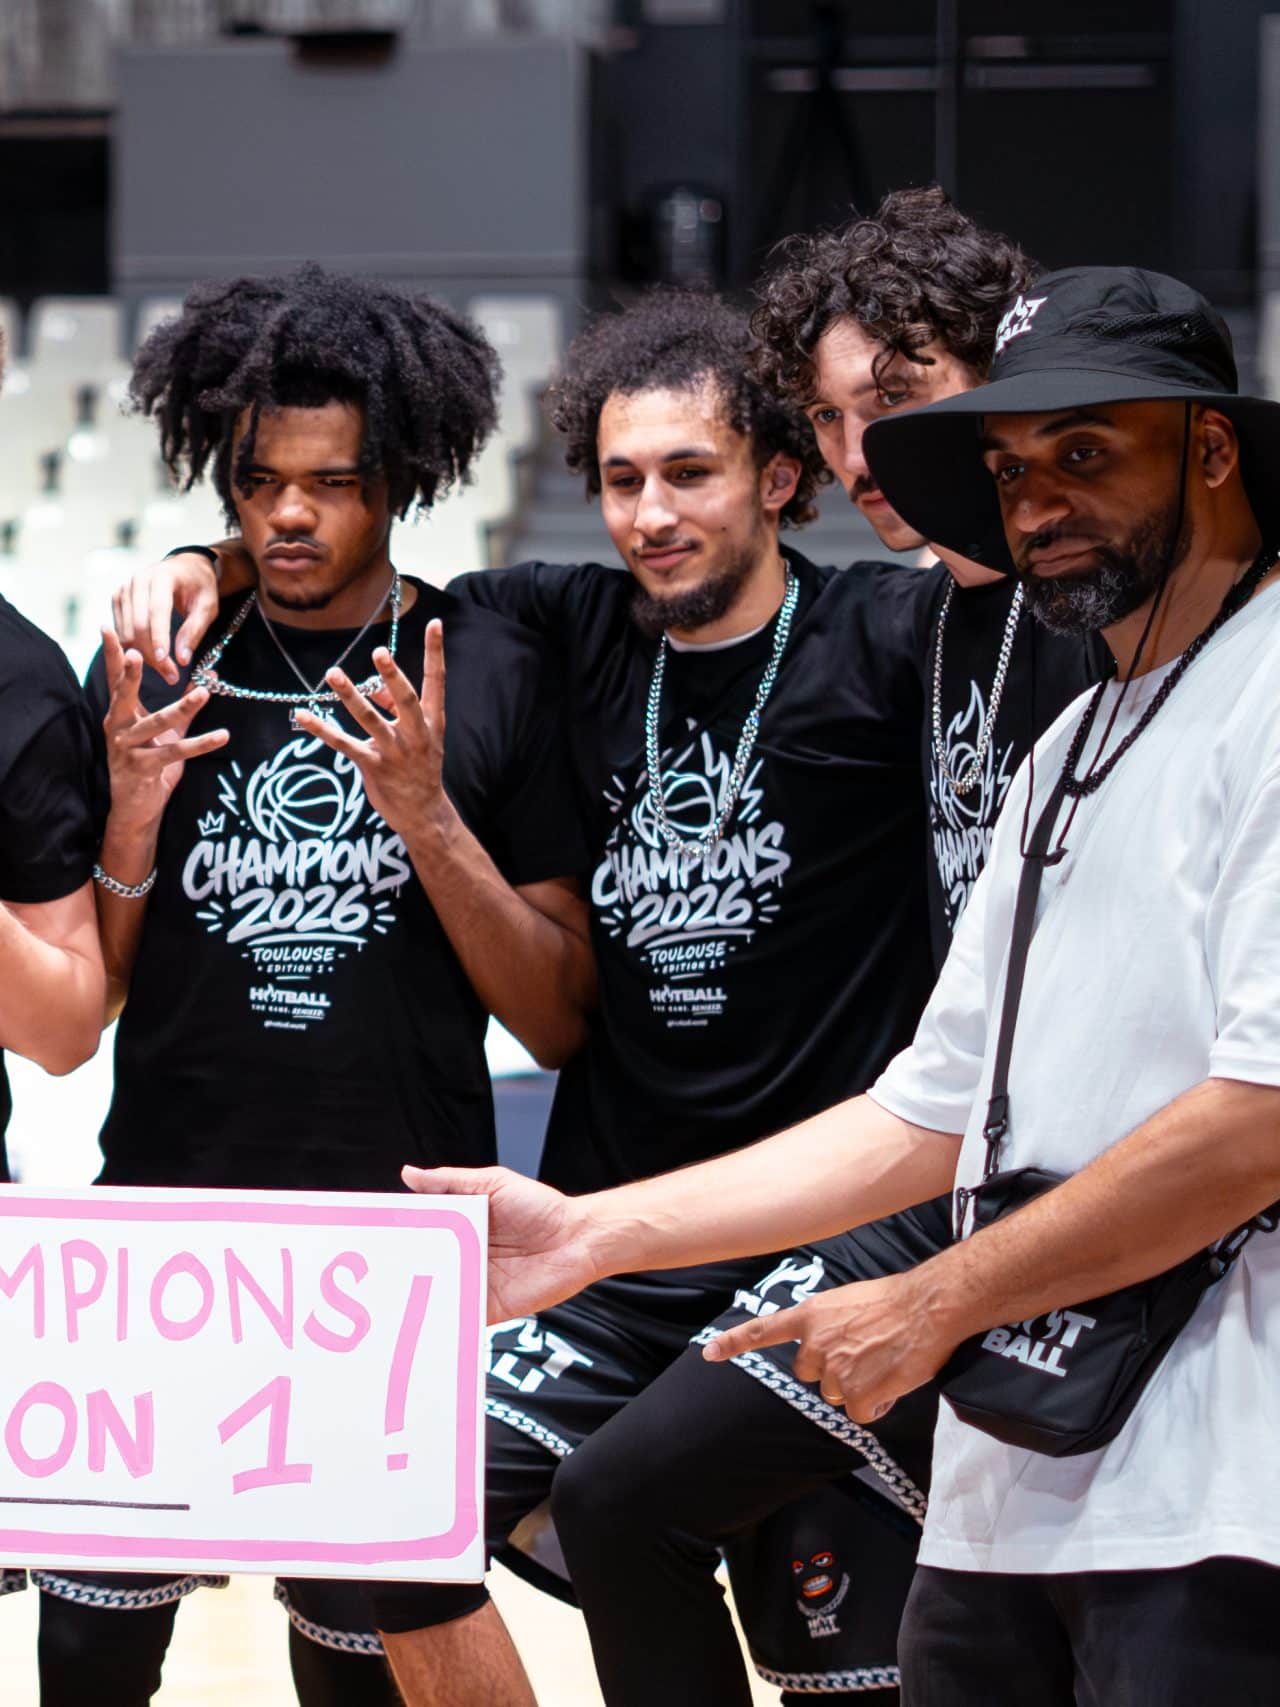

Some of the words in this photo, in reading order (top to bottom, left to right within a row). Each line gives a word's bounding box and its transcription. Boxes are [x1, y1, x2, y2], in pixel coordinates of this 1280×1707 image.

[182, 834, 411, 900] CHAMPIONS
[592, 822, 791, 906] CHAMPIONS
[226, 884, 369, 943] 2026
[627, 879, 753, 947] 2026
[252, 946, 335, 962] TOULOUSE
[267, 964, 312, 973] EDITION
[649, 941, 726, 965] TOULOUSE
[662, 960, 705, 974] EDITION
[981, 1327, 1067, 1377] BALL
[217, 1375, 313, 1495] 1
